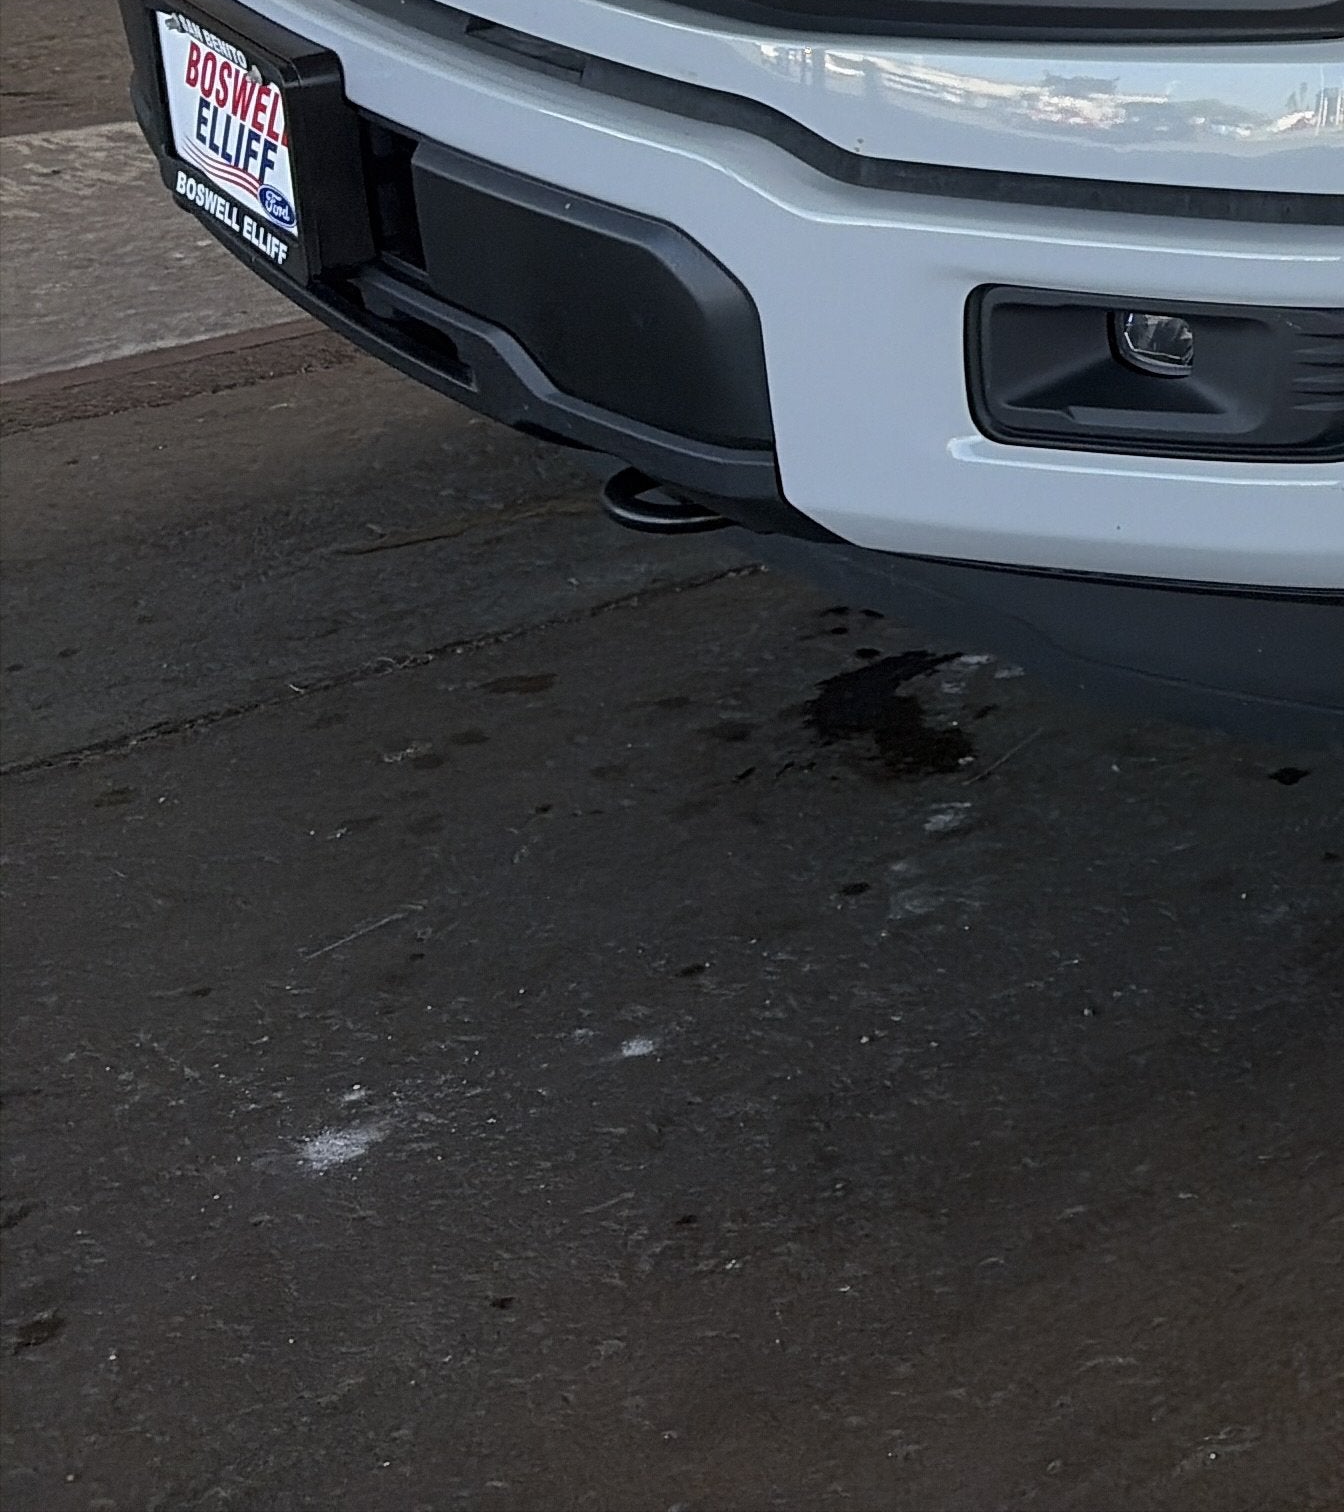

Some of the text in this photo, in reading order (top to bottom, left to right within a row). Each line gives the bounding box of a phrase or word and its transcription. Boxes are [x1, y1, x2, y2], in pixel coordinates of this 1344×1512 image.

[196, 95, 278, 186] ELLIFF
[175, 170, 288, 265] BOSWELL ELLIFF
[265, 189, 292, 223] Ford
